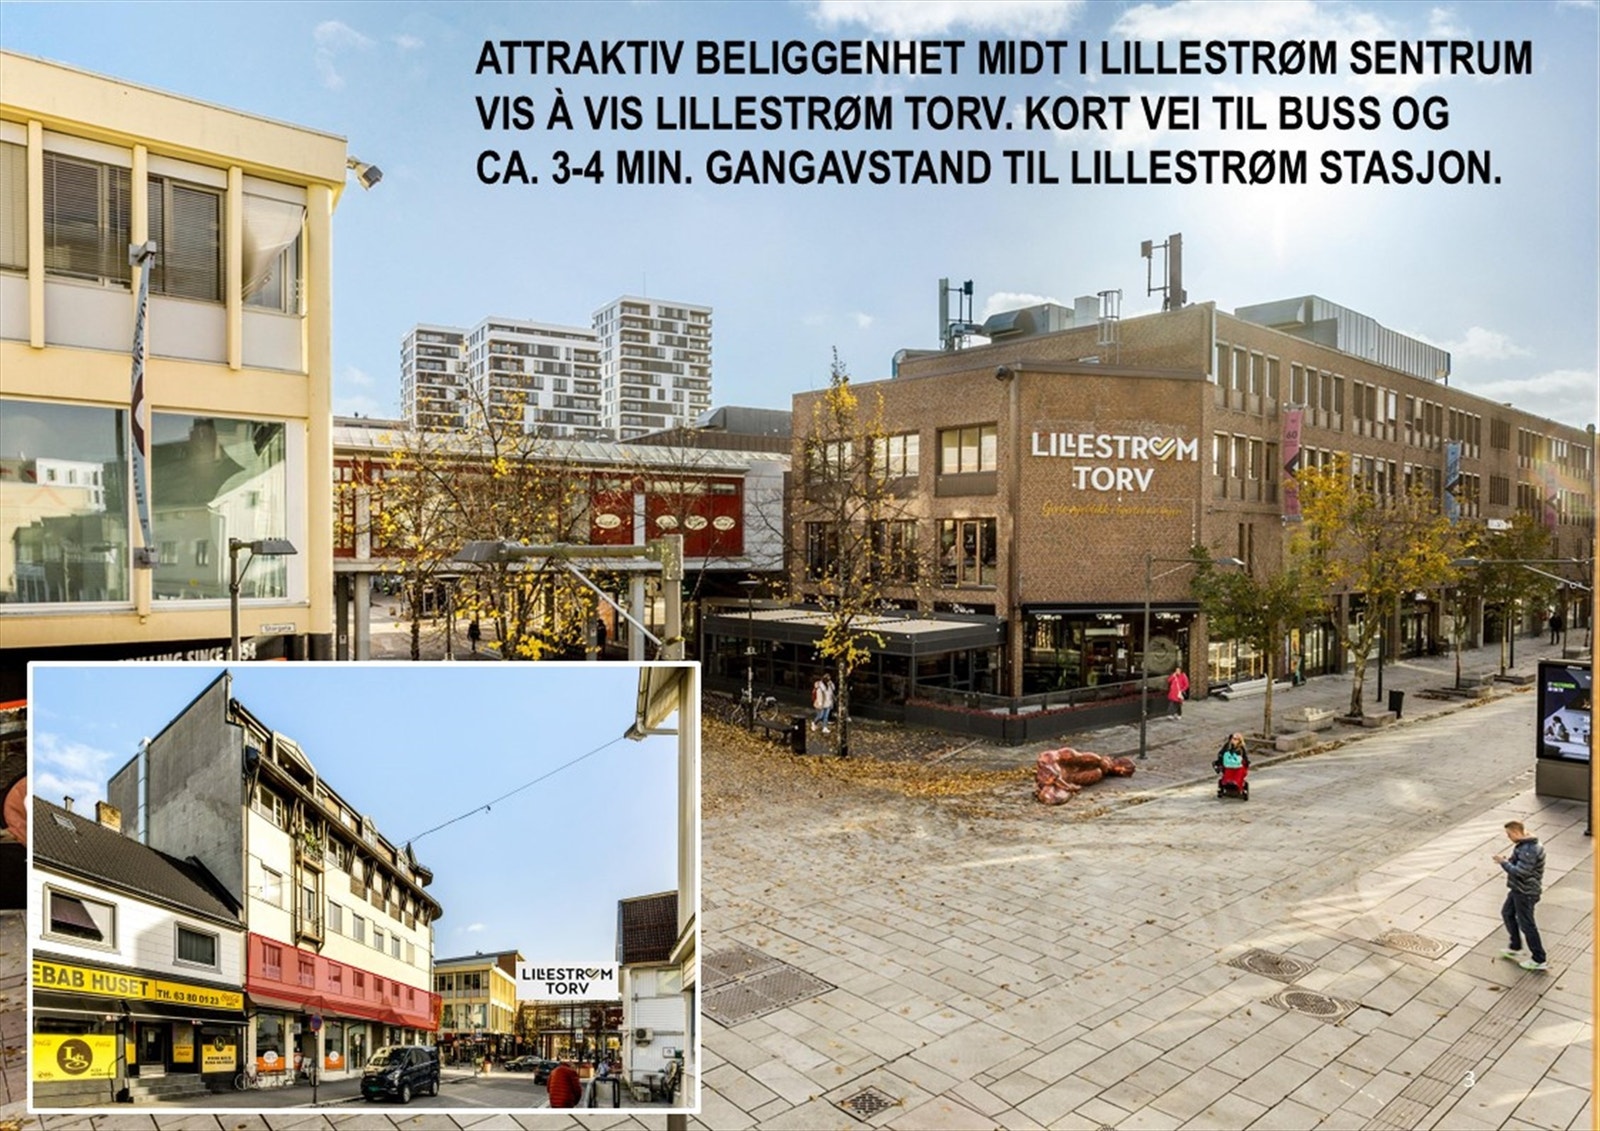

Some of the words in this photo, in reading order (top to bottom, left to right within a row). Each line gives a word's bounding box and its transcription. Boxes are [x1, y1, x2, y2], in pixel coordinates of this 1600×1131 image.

[1072, 466, 1155, 493] TORV
[226, 642, 257, 662] 154
[92, 974, 148, 996] HUSET
[173, 992, 185, 1002] 63
[186, 993, 198, 1003] 80
[199, 994, 209, 1004] 01
[210, 996, 220, 1006] 23
